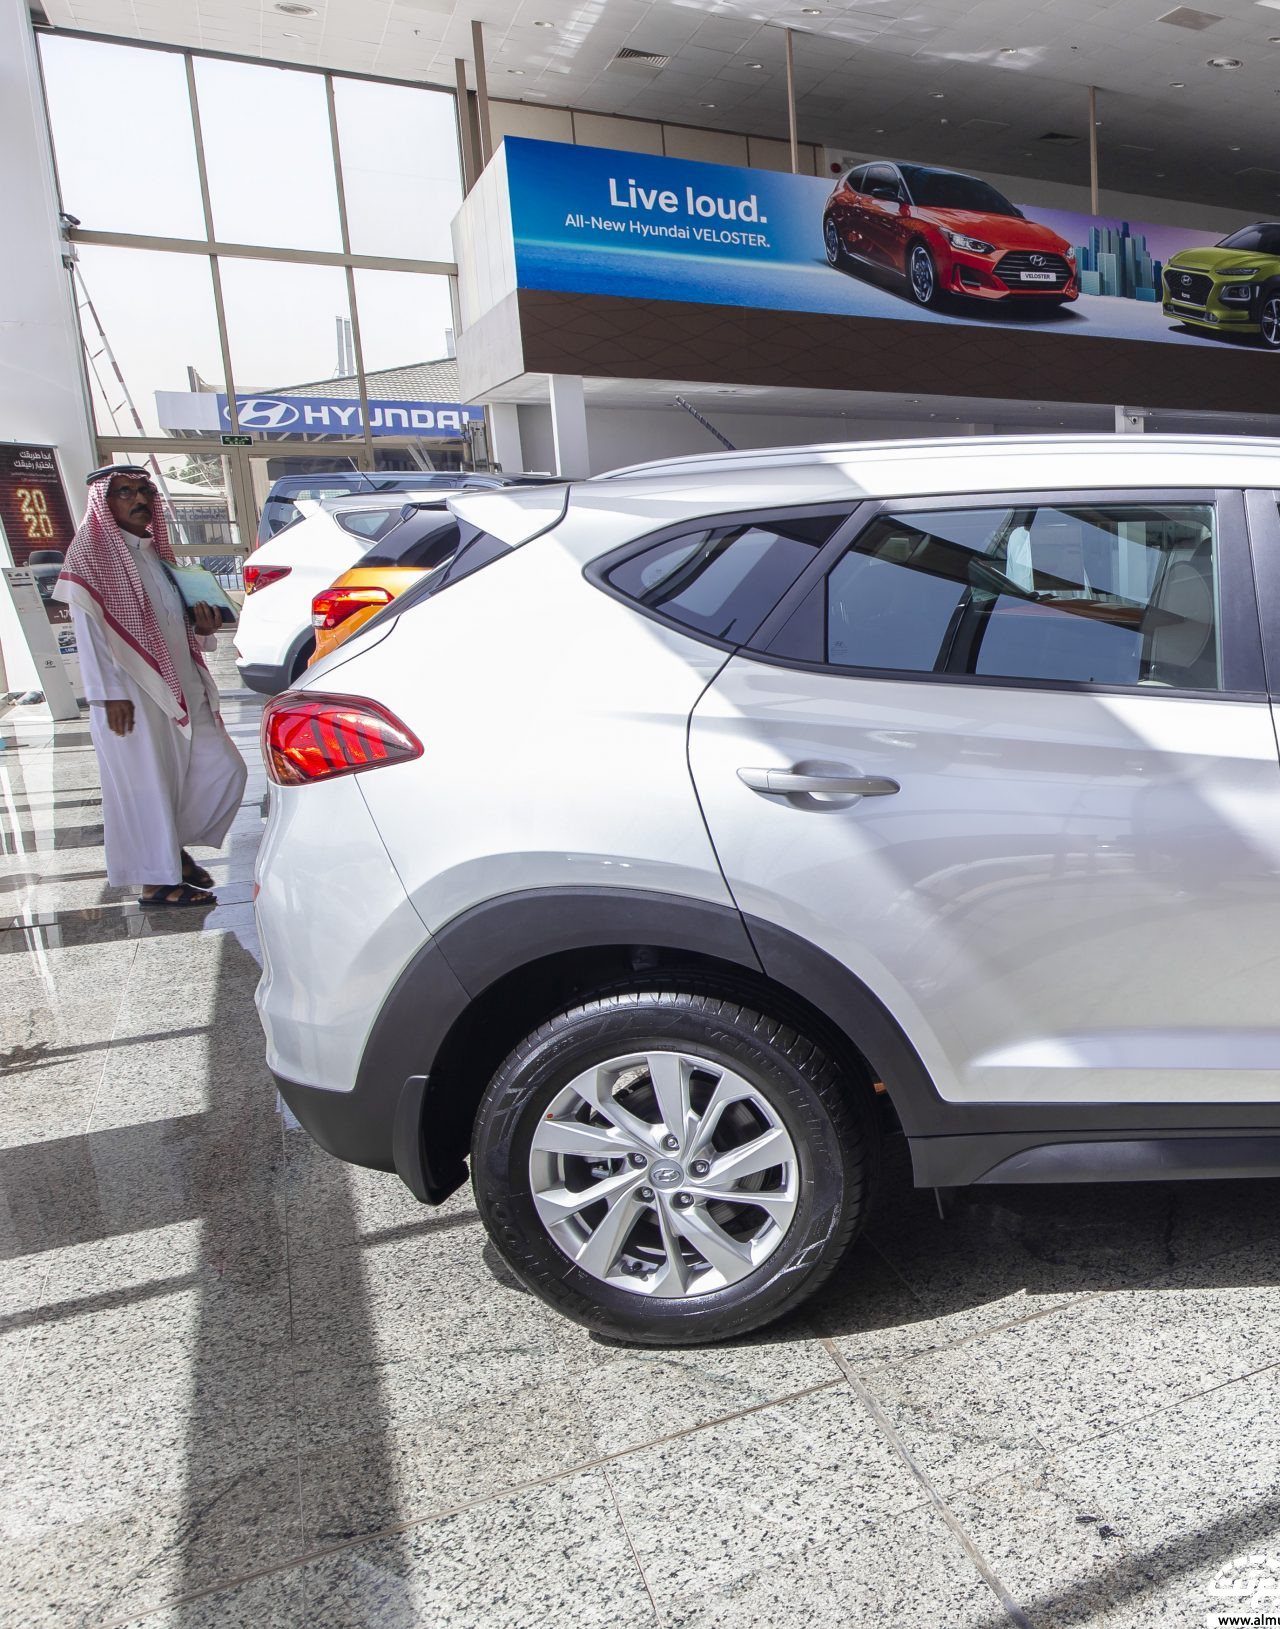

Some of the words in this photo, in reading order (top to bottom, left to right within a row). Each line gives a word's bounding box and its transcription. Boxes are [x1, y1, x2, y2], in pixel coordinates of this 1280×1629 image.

[609, 177, 679, 213] Live
[686, 186, 768, 224] loud.
[565, 213, 626, 232] All-New
[629, 220, 690, 239] Hyundai
[692, 228, 771, 248] VELOSTER.
[304, 404, 470, 430] HYUNDAI
[16, 488, 47, 513] 20
[24, 513, 54, 538] 20
